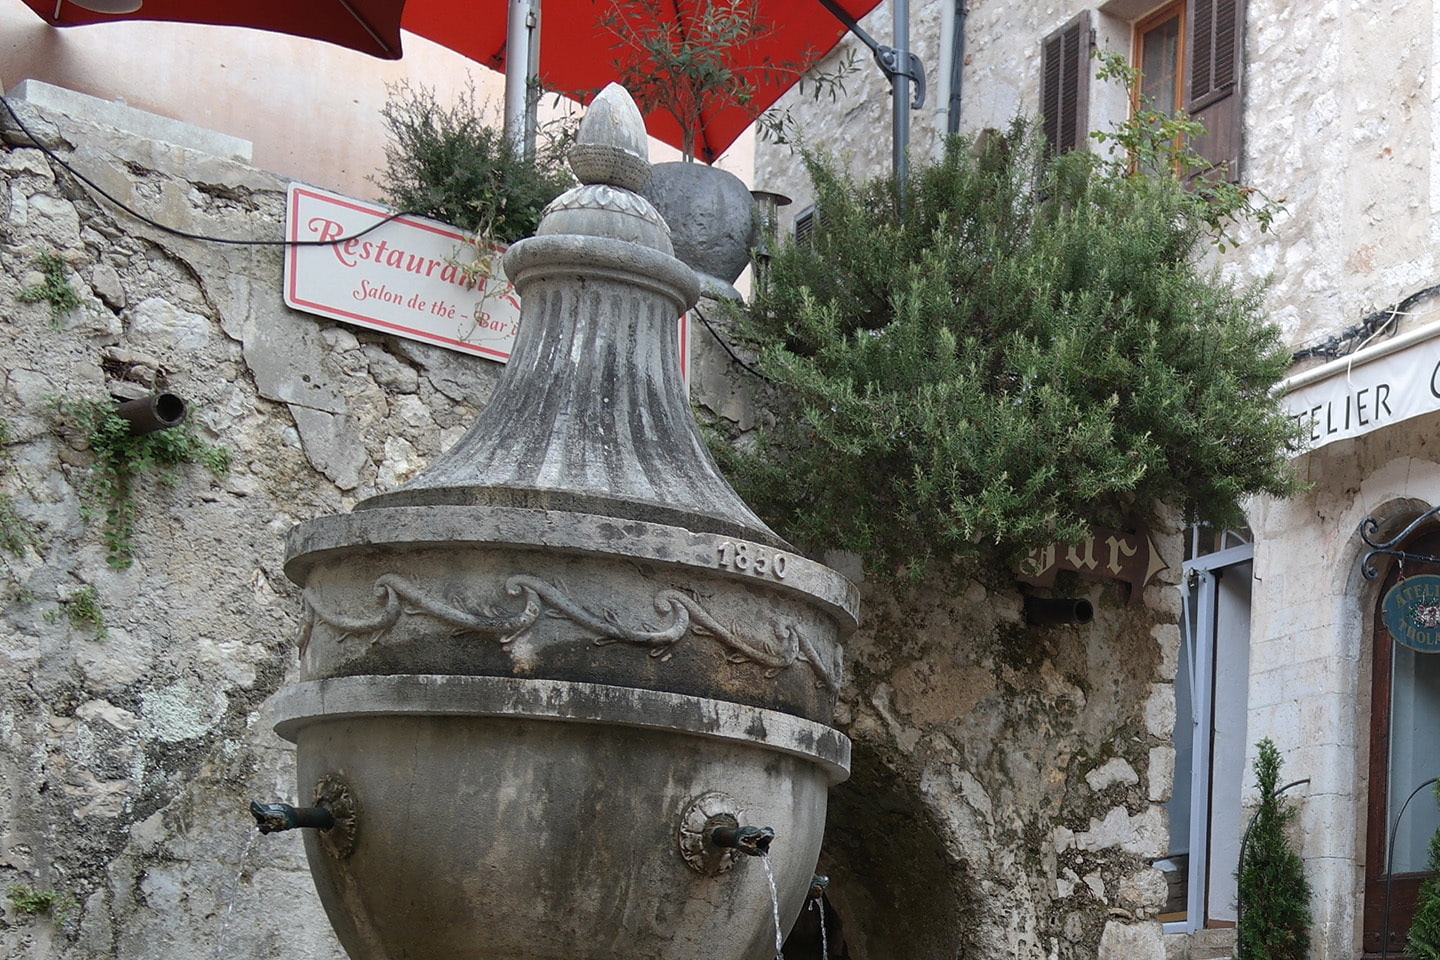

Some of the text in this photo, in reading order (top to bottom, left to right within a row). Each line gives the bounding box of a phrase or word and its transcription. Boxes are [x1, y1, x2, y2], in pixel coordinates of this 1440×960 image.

[352, 279, 403, 307] Salon
[407, 294, 426, 313] de
[430, 300, 456, 320] thé
[474, 310, 508, 332] Bar
[1287, 383, 1393, 449] TELIER
[717, 541, 788, 580] 1850
